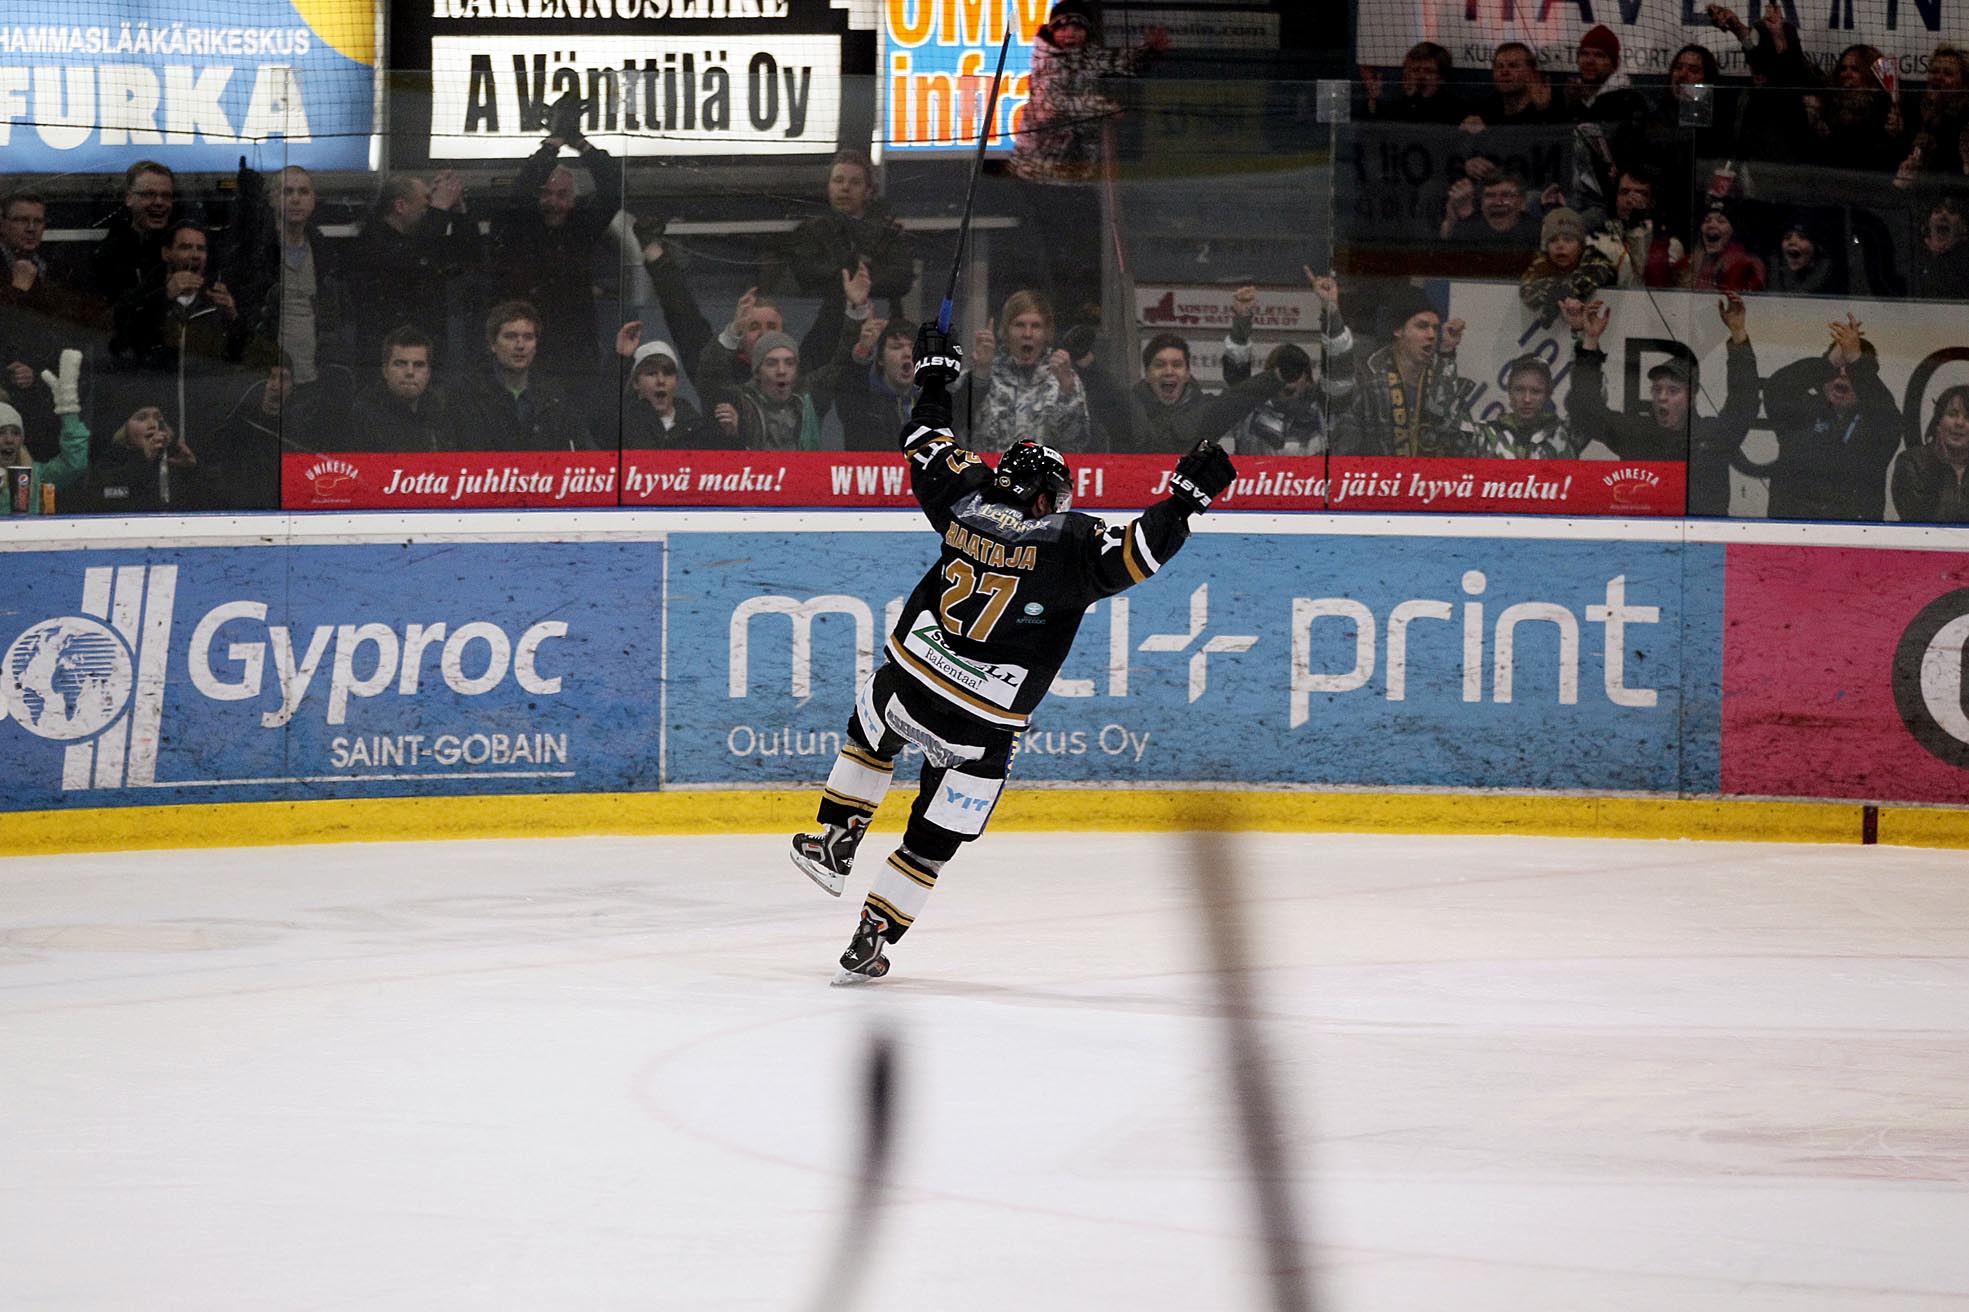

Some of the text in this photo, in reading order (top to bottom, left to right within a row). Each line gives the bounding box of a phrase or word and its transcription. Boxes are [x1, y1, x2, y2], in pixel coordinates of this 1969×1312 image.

[0, 22, 311, 56] HAMMASLÄÄKÄRIKESKUS
[0, 65, 313, 150] FURKA
[464, 54, 499, 132] A
[748, 51, 812, 138] Oy
[305, 460, 359, 480] UNIRESTA
[383, 466, 786, 500] Jotta juhlista jäisi hyvä maku!
[1221, 471, 1573, 504] juhlista jäisi hyvä maku!
[1602, 468, 1660, 487] UNIRESTA
[945, 520, 1037, 571] HAATAJA
[939, 557, 1020, 643] 27
[188, 600, 568, 729] Gyproc
[924, 647, 984, 691] Rakentaa!
[330, 733, 568, 768] SAINT-GOBAIN
[727, 725, 840, 756] Oulun
[1098, 724, 1151, 762] Oy
[946, 785, 989, 812] YIT
